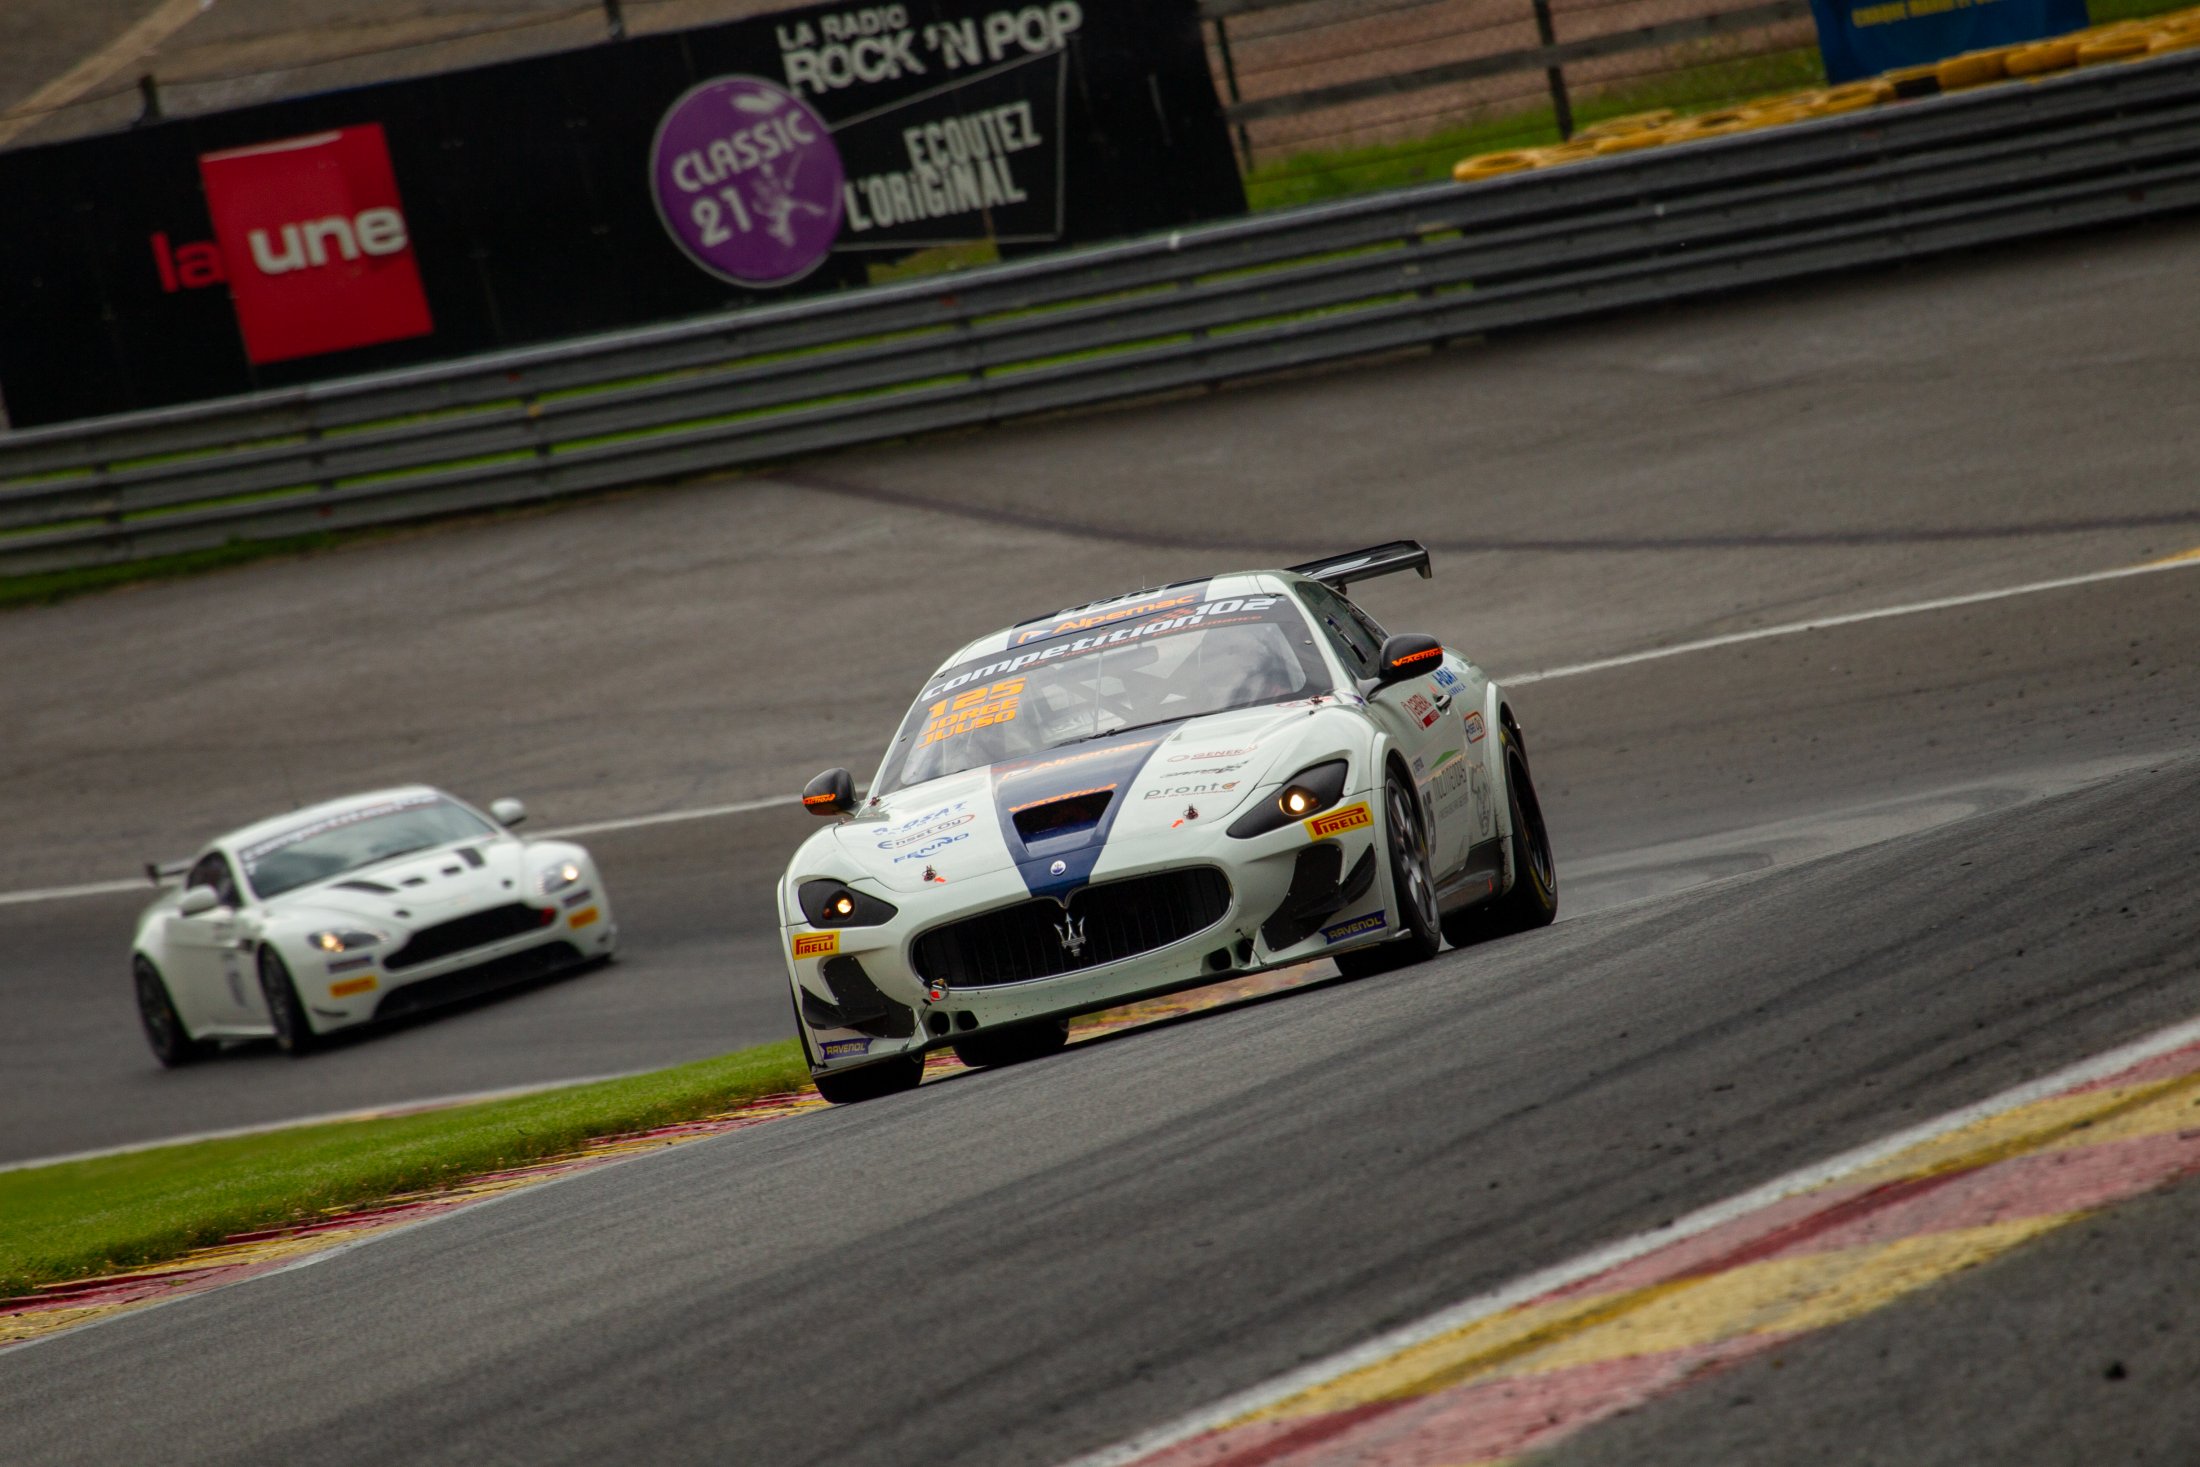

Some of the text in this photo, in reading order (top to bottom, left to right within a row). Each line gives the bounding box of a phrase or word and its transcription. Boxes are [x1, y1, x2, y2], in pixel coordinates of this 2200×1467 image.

[776, 5, 909, 50] LA RADIO
[783, 31, 927, 97] ROCK
[984, 1, 1083, 61] POP
[672, 108, 816, 193] CLASSIC
[903, 100, 1042, 170] ECOUTEZ
[690, 187, 753, 247] 21
[150, 206, 409, 294] la une
[1052, 593, 1198, 635] Alpemac
[922, 697, 1020, 737] JORGE
[927, 677, 1026, 719] 125
[918, 709, 1018, 749] JUUSO
[1144, 781, 1239, 800] pronto
[1311, 807, 1369, 836] PIRELLI
[795, 934, 835, 955] PIRELLI
[1328, 916, 1382, 939] RAVENOL
[826, 1042, 866, 1055] RAVENOL
